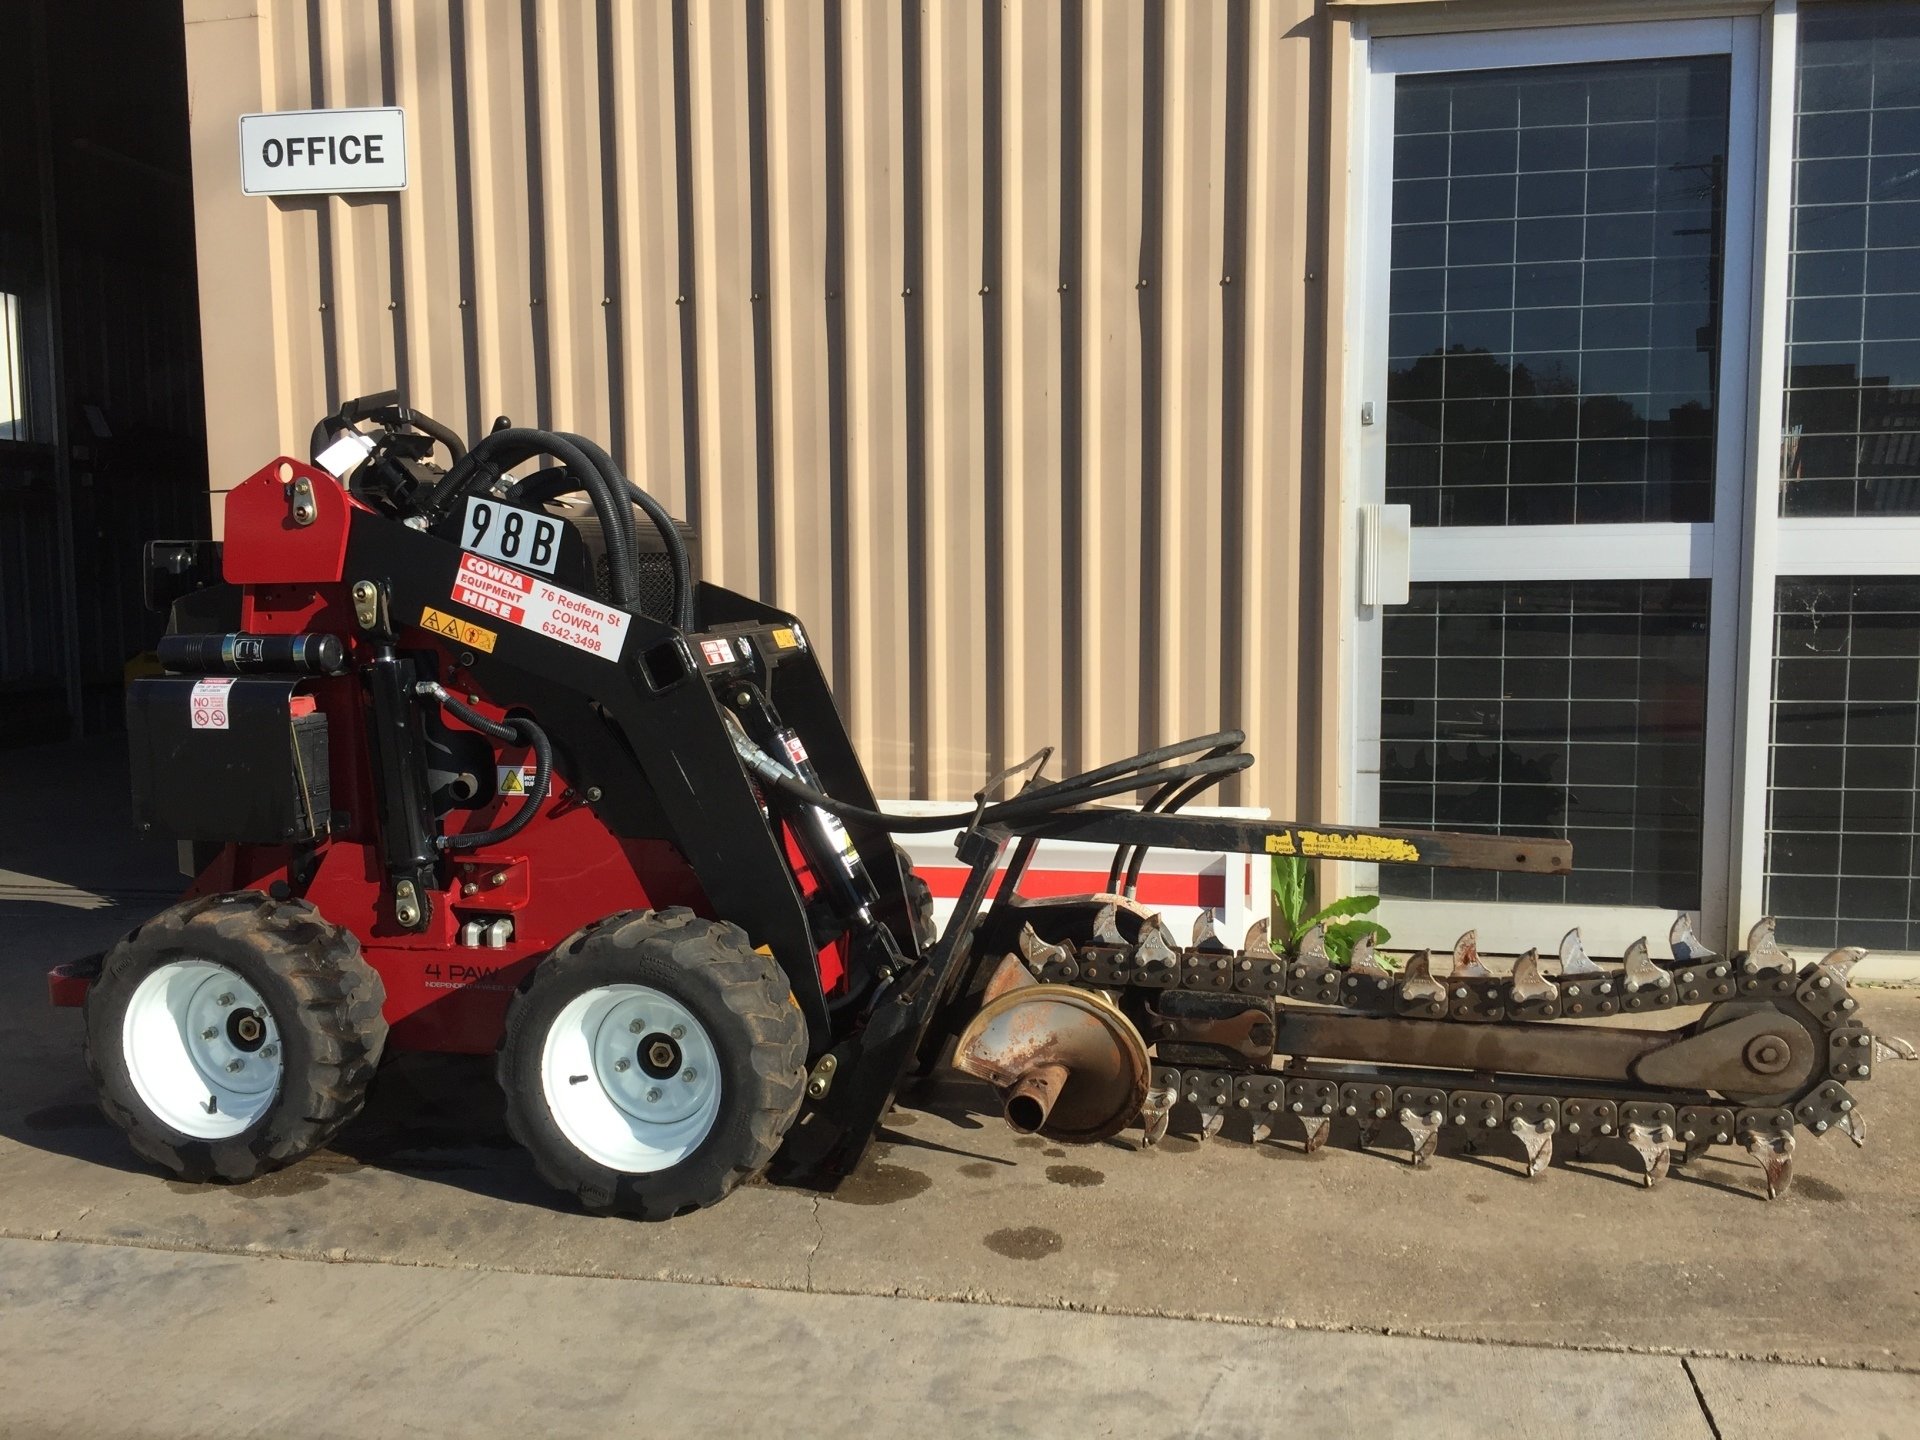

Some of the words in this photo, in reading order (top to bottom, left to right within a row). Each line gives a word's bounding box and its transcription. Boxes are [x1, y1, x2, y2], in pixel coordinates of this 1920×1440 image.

[262, 134, 384, 168] OFFICE
[470, 503, 555, 566] 98B
[460, 574, 523, 603] EQUIPMENT
[466, 557, 524, 590] COWRA
[461, 589, 513, 619] HIRE
[540, 588, 554, 602] 76
[557, 594, 604, 621] Redfern
[607, 613, 621, 627] St
[541, 621, 602, 652] 6342-3498
[552, 609, 600, 635] COWRA
[194, 697, 209, 707] NO
[425, 964, 441, 980] 4
